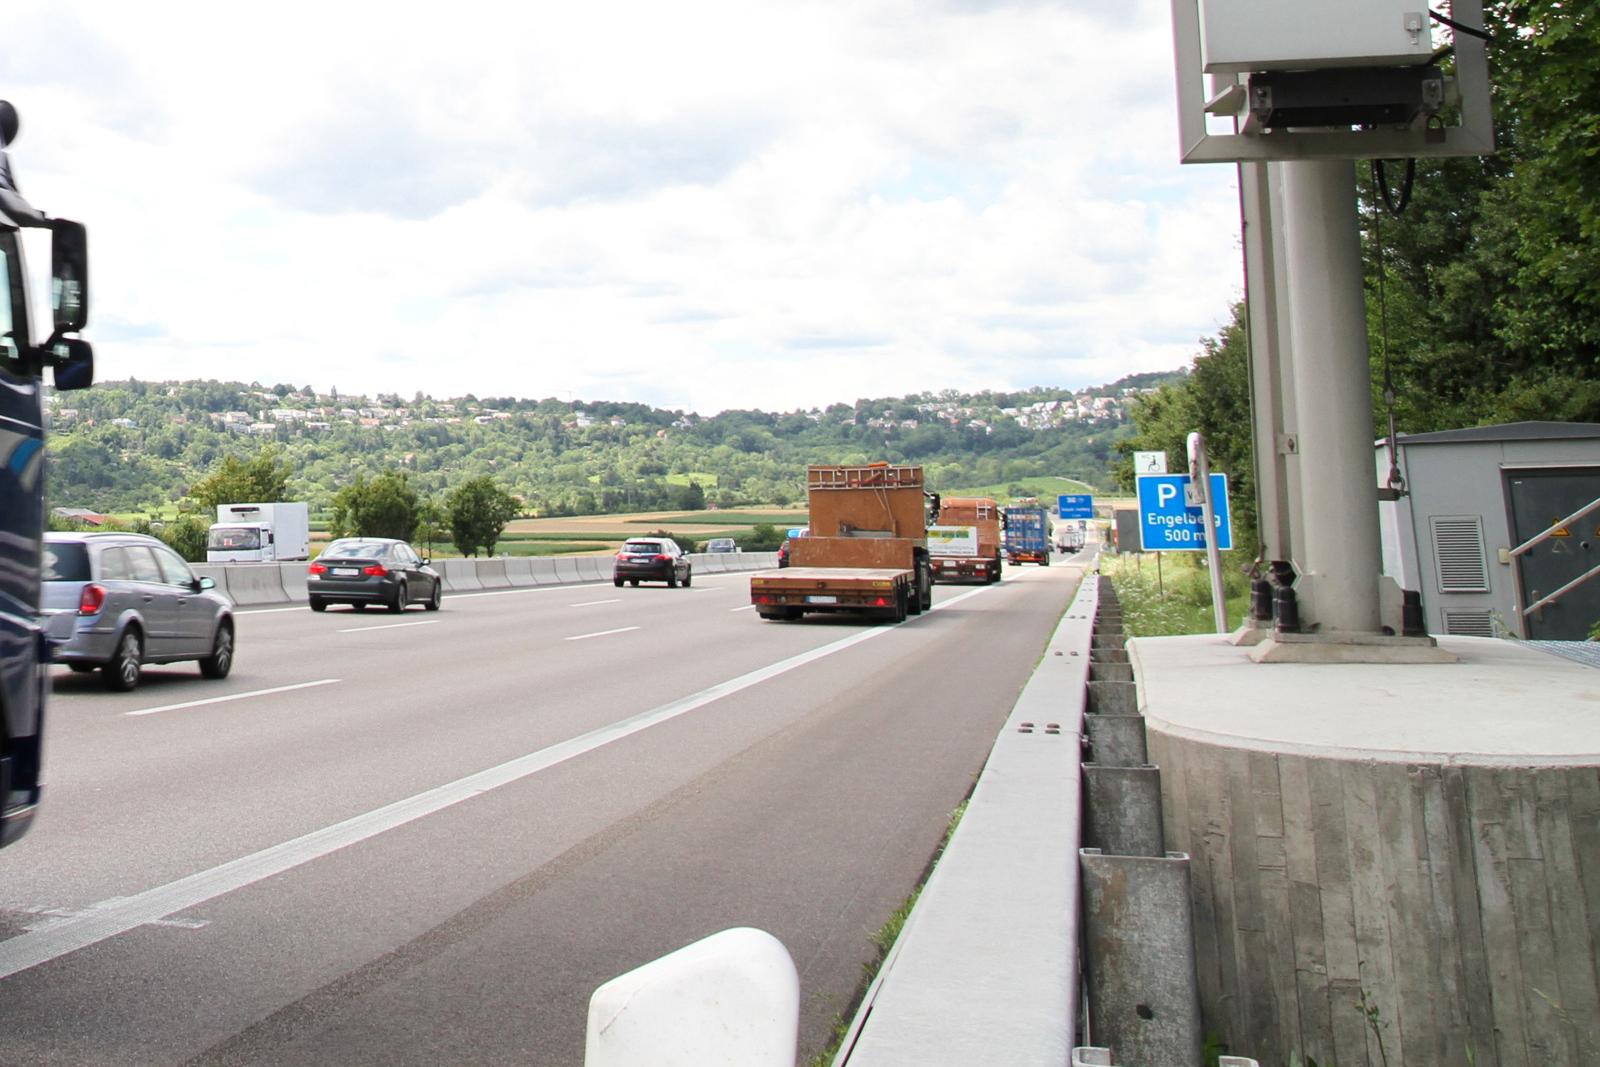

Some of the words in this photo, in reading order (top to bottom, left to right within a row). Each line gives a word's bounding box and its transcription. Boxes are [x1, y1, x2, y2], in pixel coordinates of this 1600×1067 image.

[1157, 483, 1177, 508] P
[1147, 512, 1222, 528] Engelbeg
[1164, 529, 1190, 542] 500
